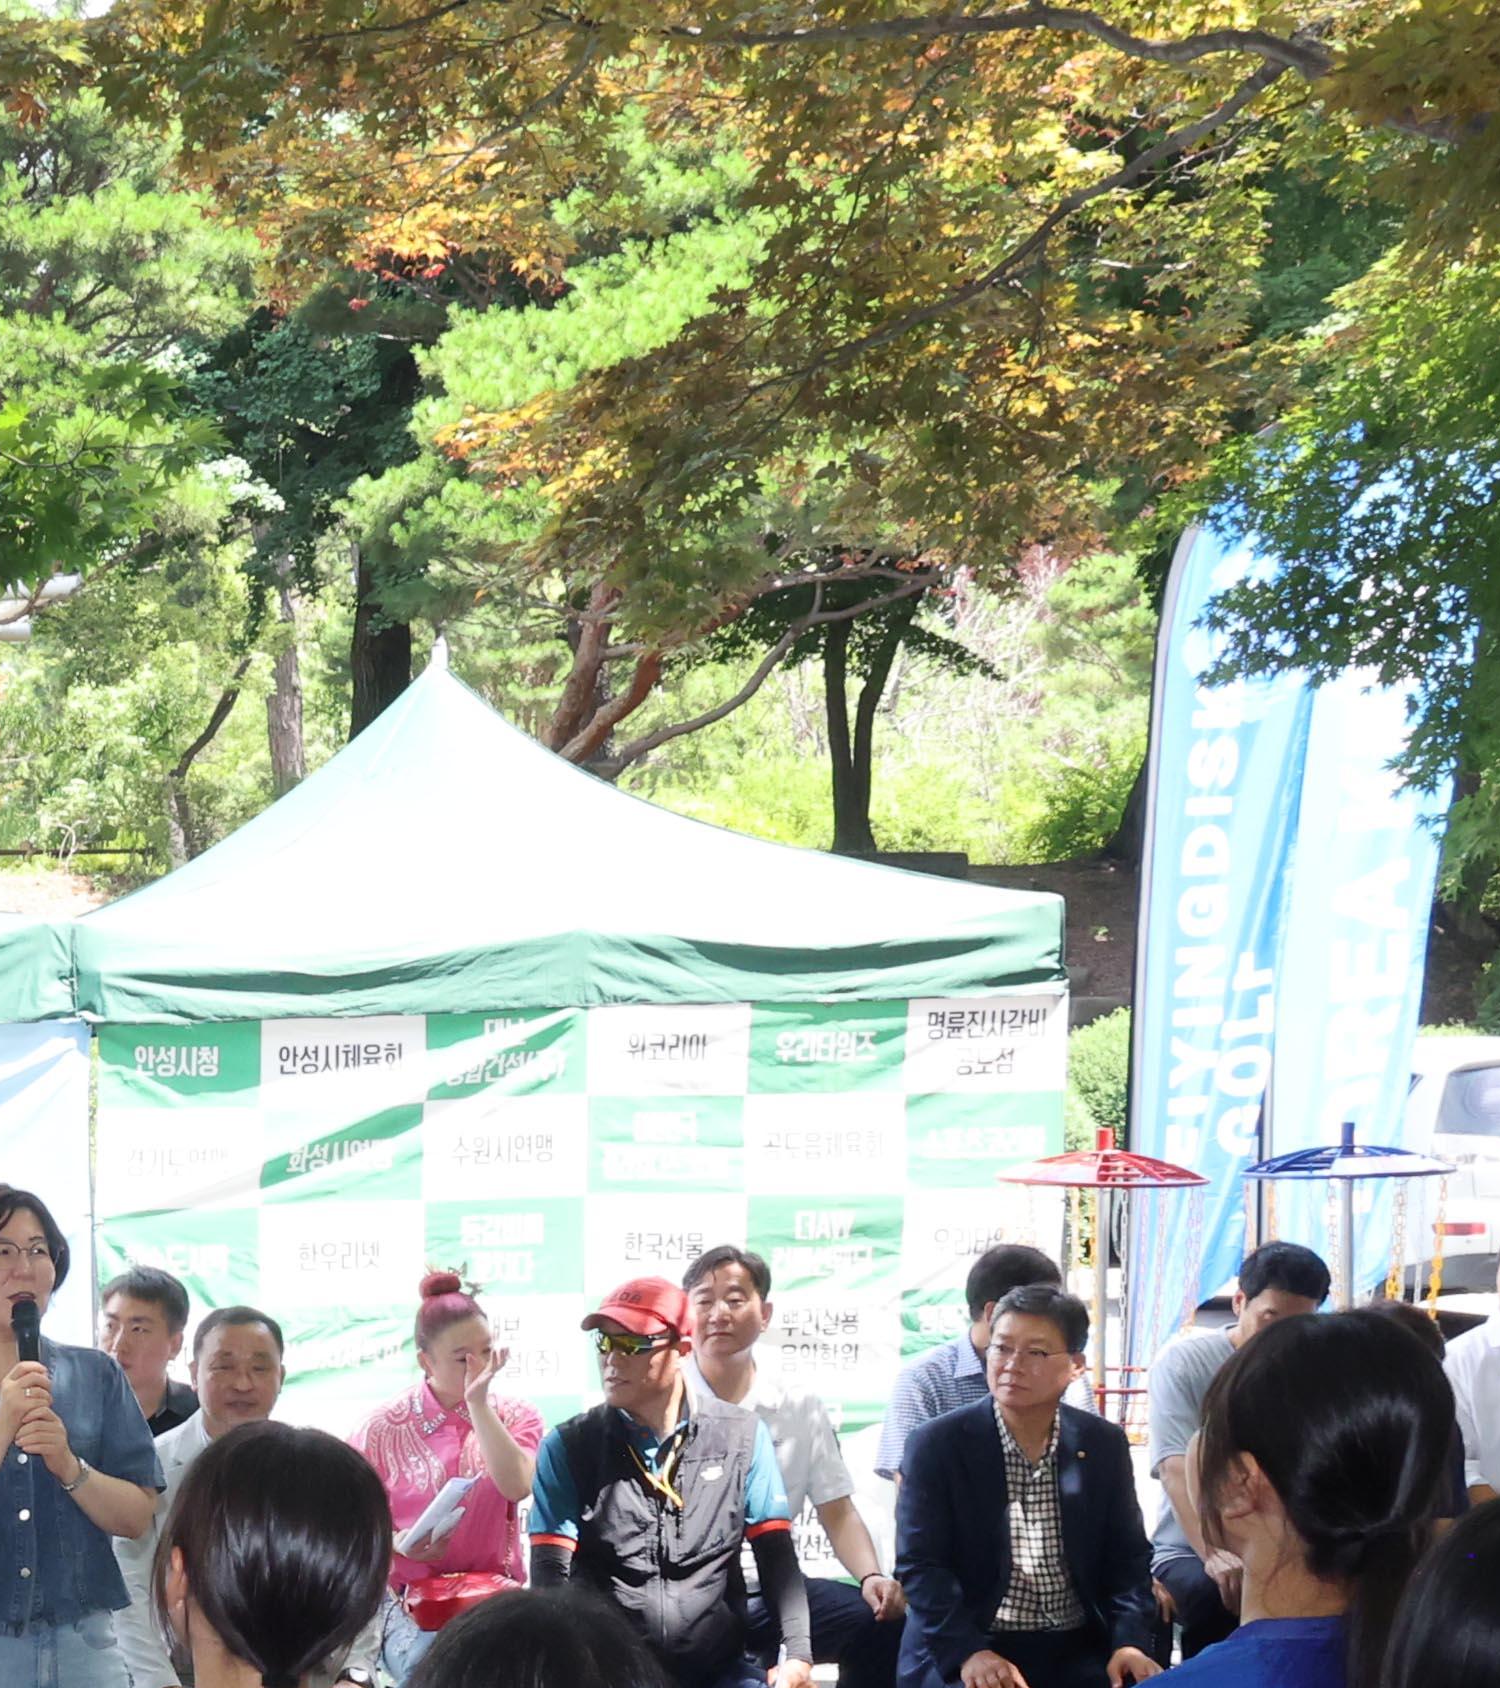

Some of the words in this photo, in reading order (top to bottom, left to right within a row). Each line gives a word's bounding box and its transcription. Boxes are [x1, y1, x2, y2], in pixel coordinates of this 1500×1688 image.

[927, 1008, 1046, 1040] 명륜진사갈비
[1320, 858, 1412, 1205] OREA
[134, 1046, 218, 1076] 안성시청
[279, 1042, 403, 1075] 안성시체육회
[627, 1032, 708, 1062] 위코리아
[776, 1031, 877, 1062] 우리타임즈
[451, 1133, 554, 1164] 수원시연맹
[298, 1241, 380, 1272] 한우리넷
[623, 1232, 704, 1264] 한국선물
[781, 1343, 859, 1372] 음악학원
